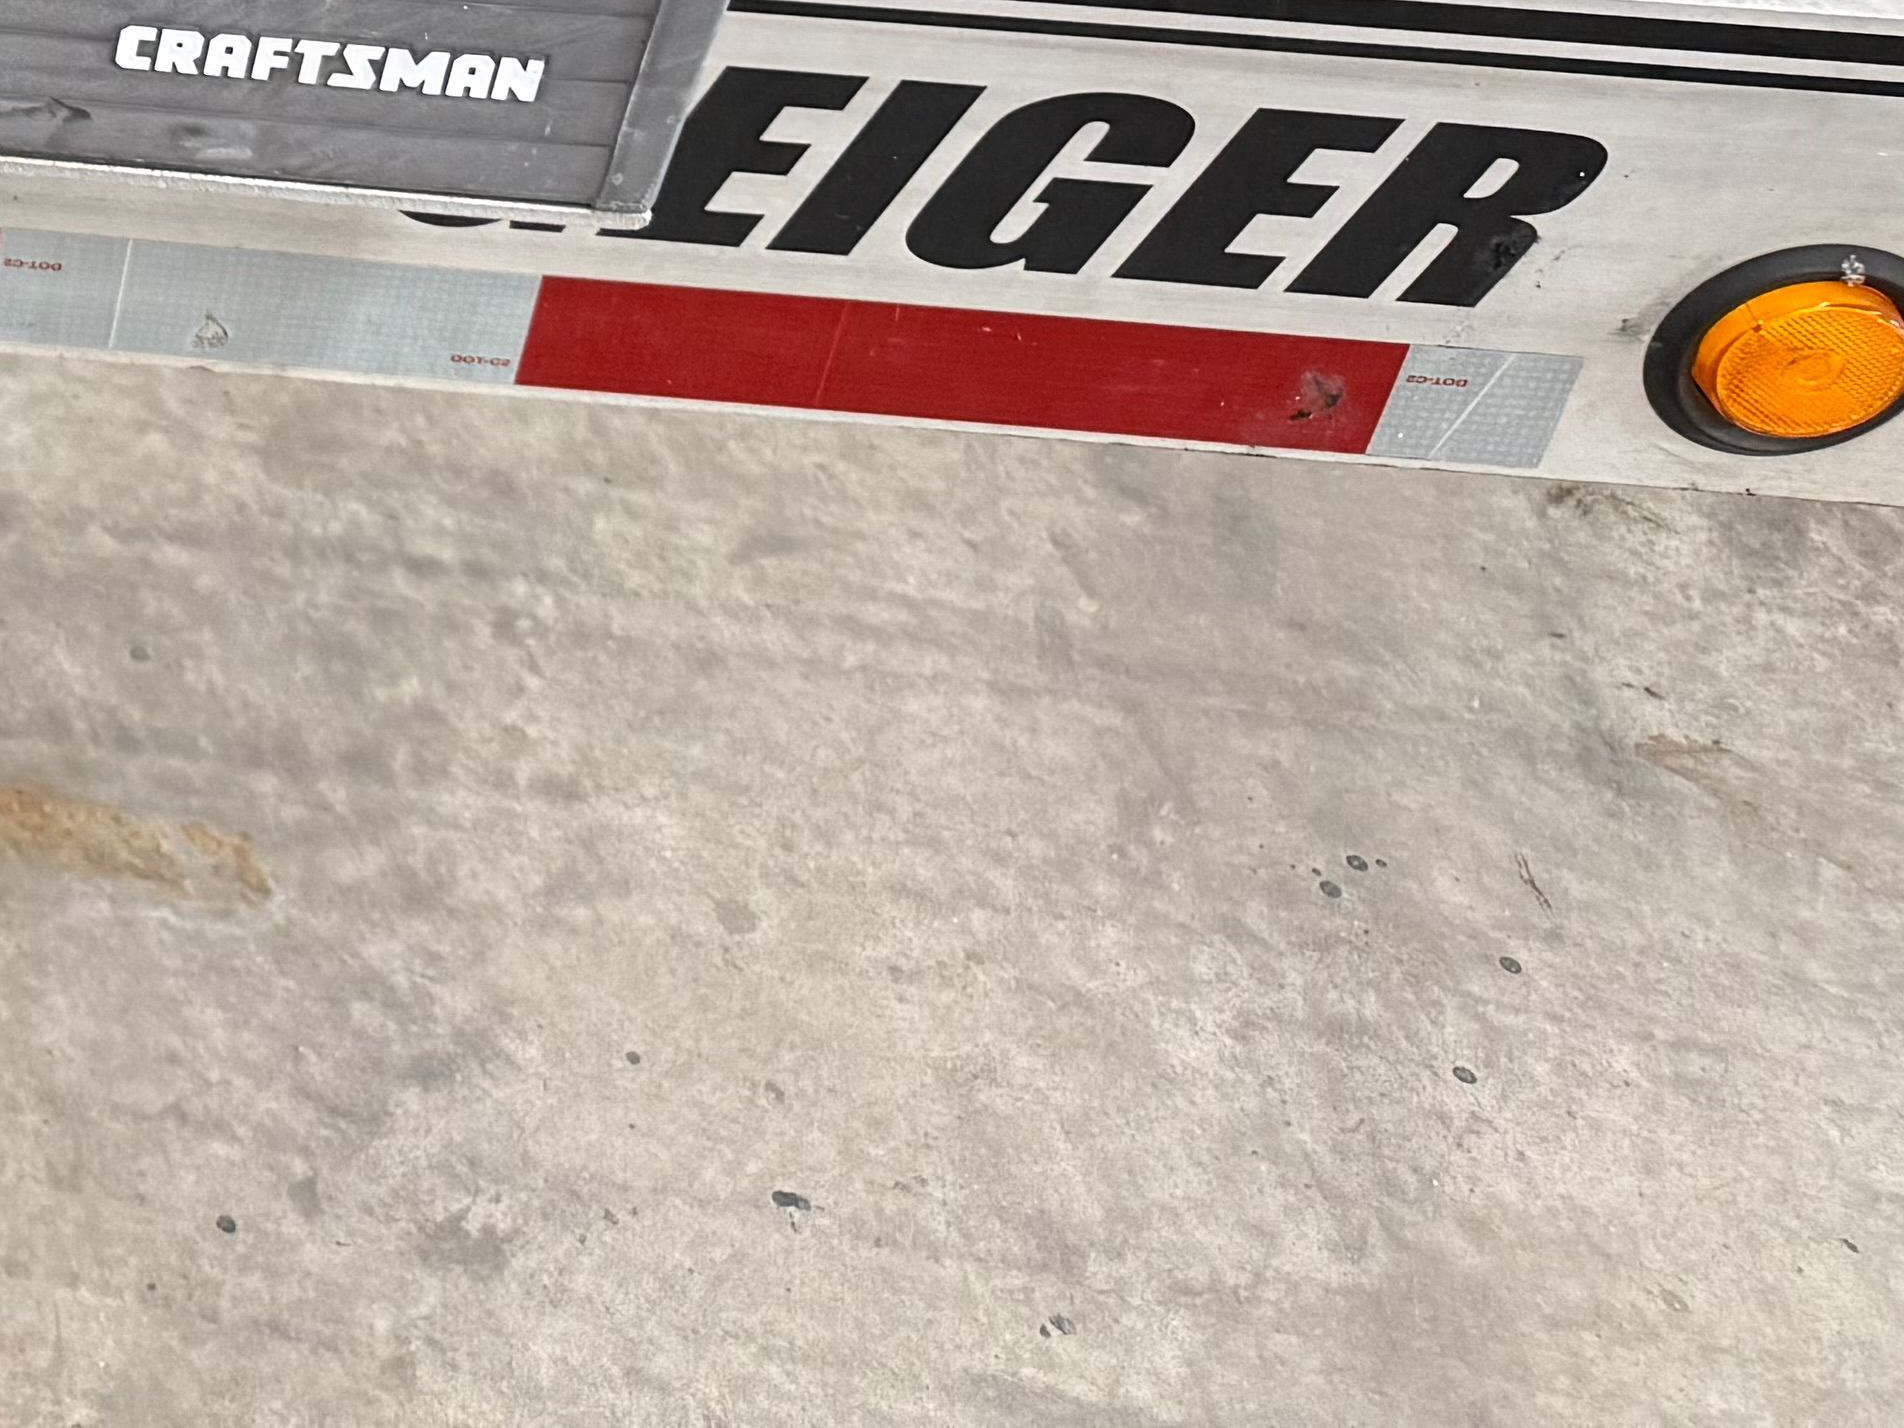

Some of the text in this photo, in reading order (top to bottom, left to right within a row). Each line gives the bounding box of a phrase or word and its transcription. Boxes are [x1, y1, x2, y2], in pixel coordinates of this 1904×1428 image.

[115, 25, 546, 102] CRAFTSMAN
[397, 65, 1608, 307] EIGER
[3, 256, 62, 273] DOT-C2
[451, 352, 511, 368] DOT-C2
[1405, 374, 1468, 388] DOT-C2
